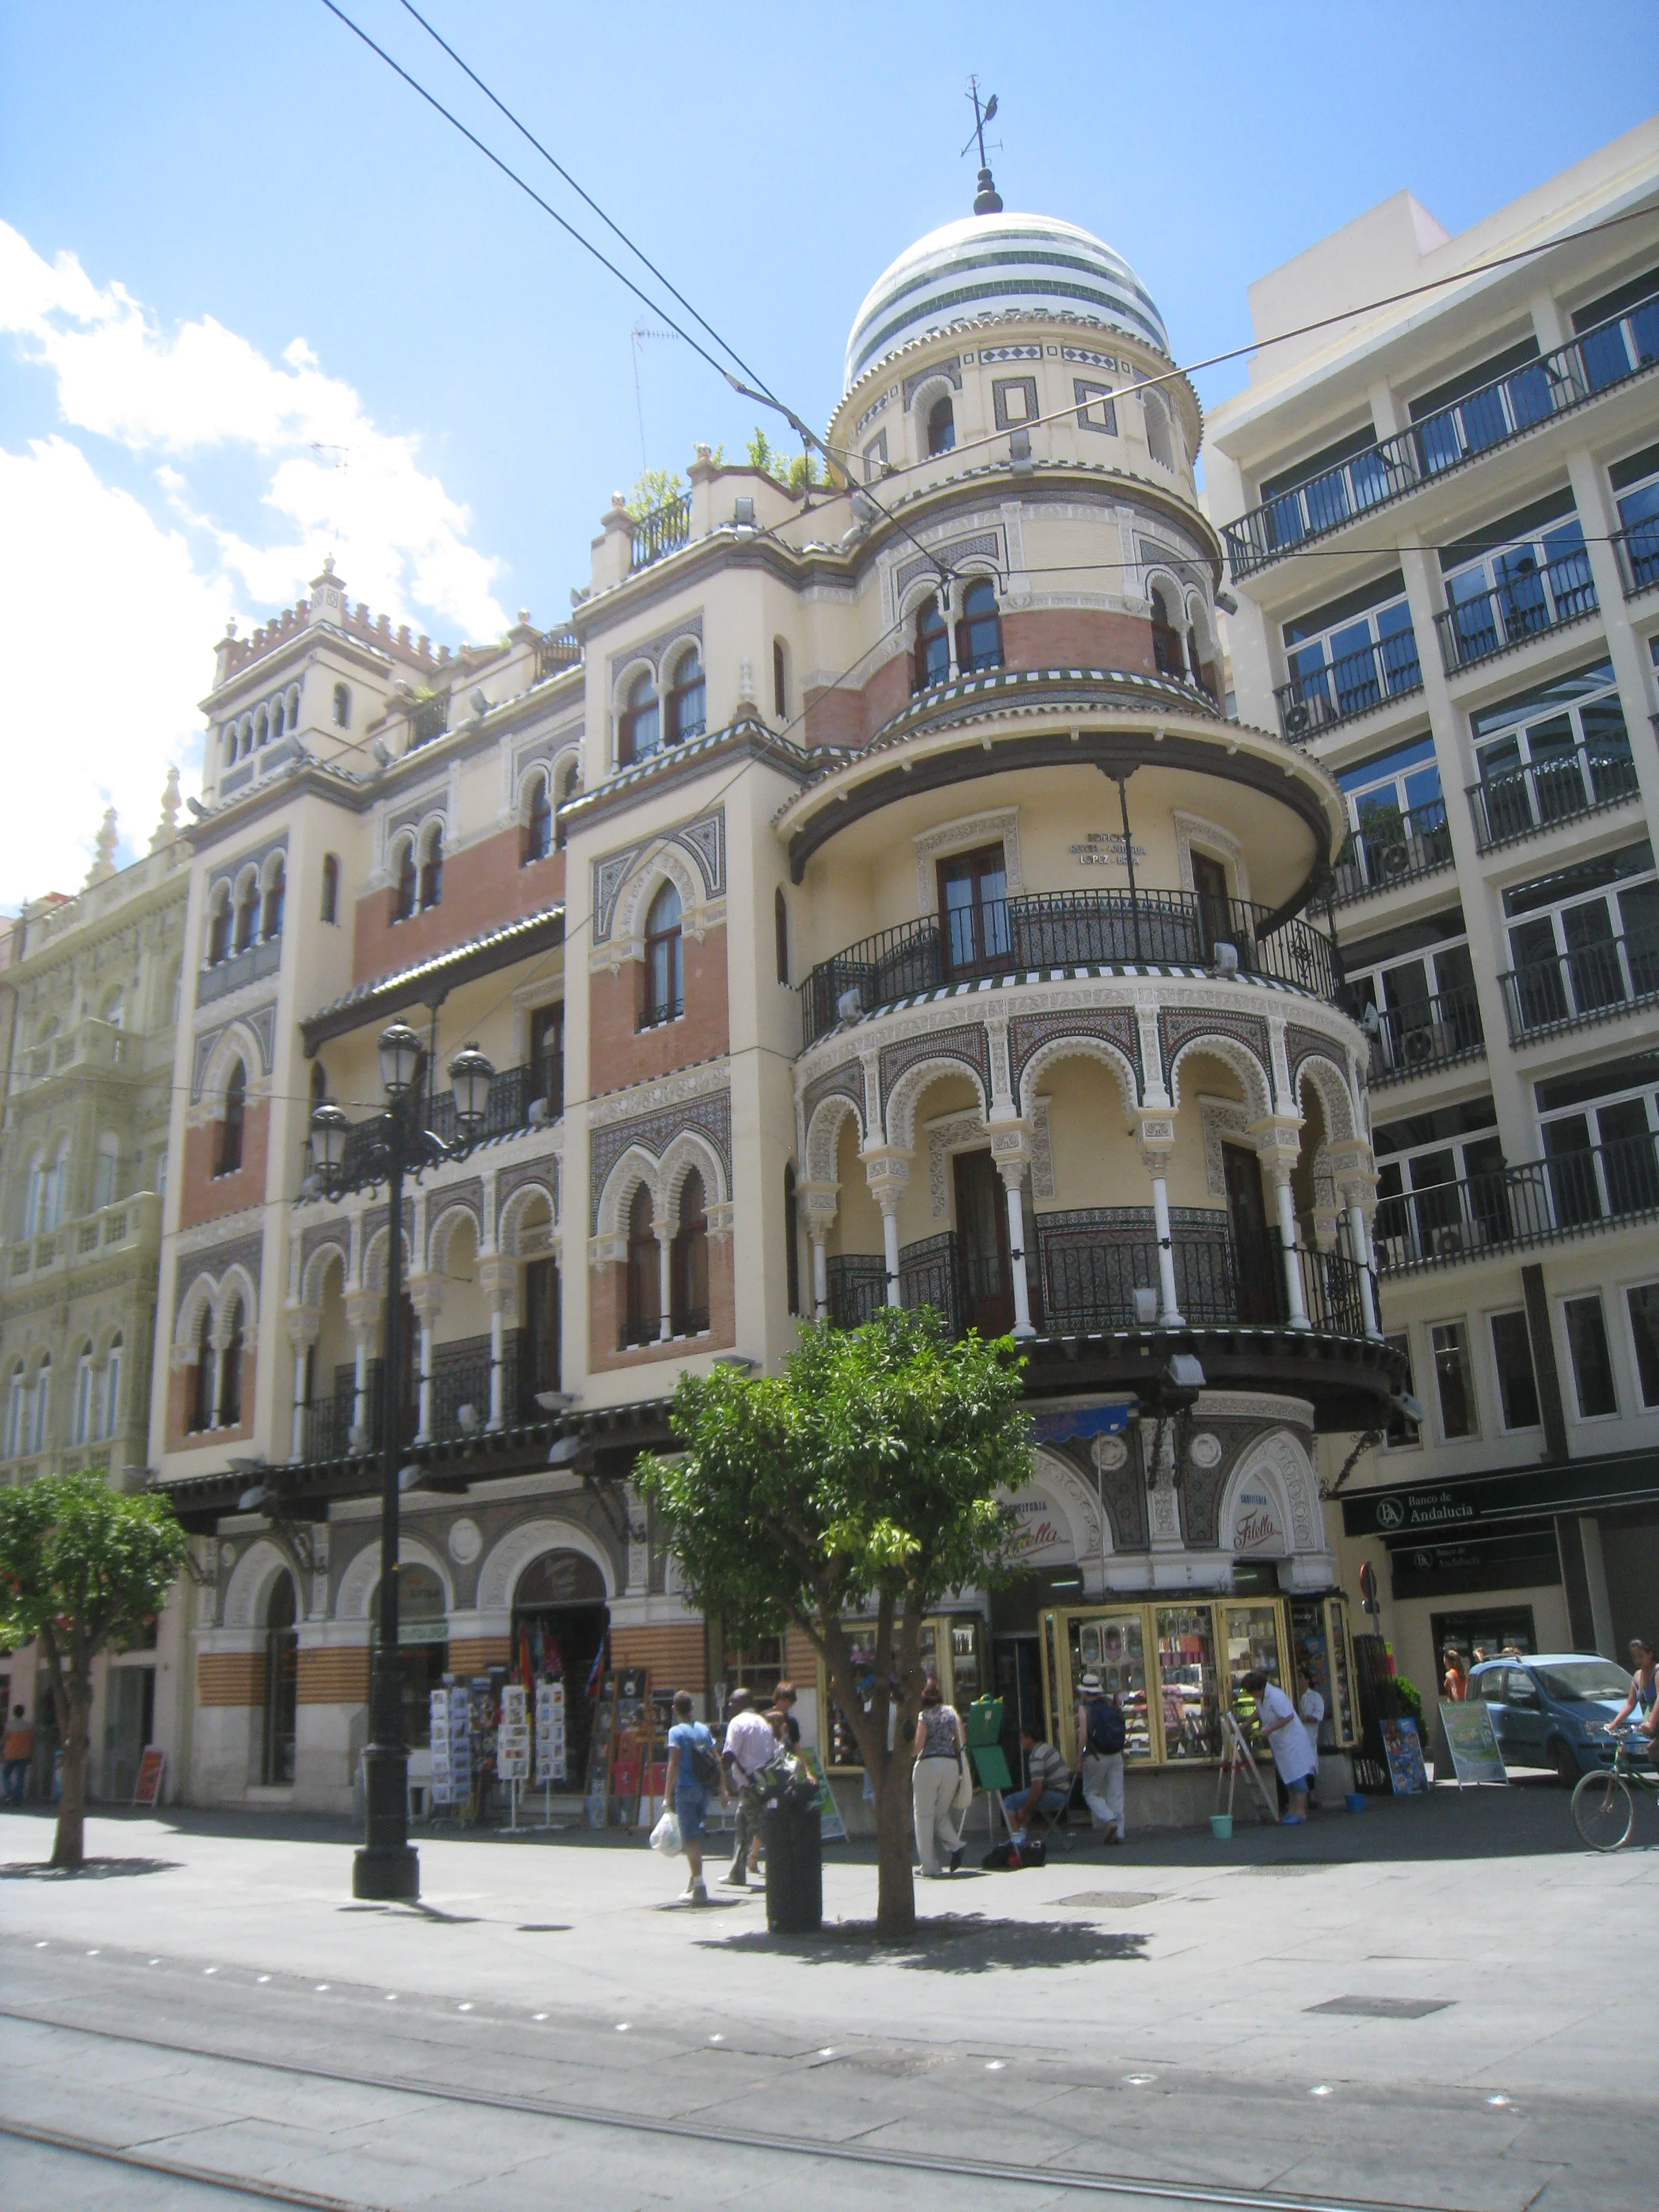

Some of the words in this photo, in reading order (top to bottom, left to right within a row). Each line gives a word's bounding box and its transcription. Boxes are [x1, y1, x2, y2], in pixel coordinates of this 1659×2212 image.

[1070, 844, 1099, 854] RENTA
[1117, 855, 1139, 866] BRA
[1408, 1495, 1437, 1507] Banco
[1440, 1492, 1452, 1502] de
[1410, 1503, 1473, 1523] Andalucía
